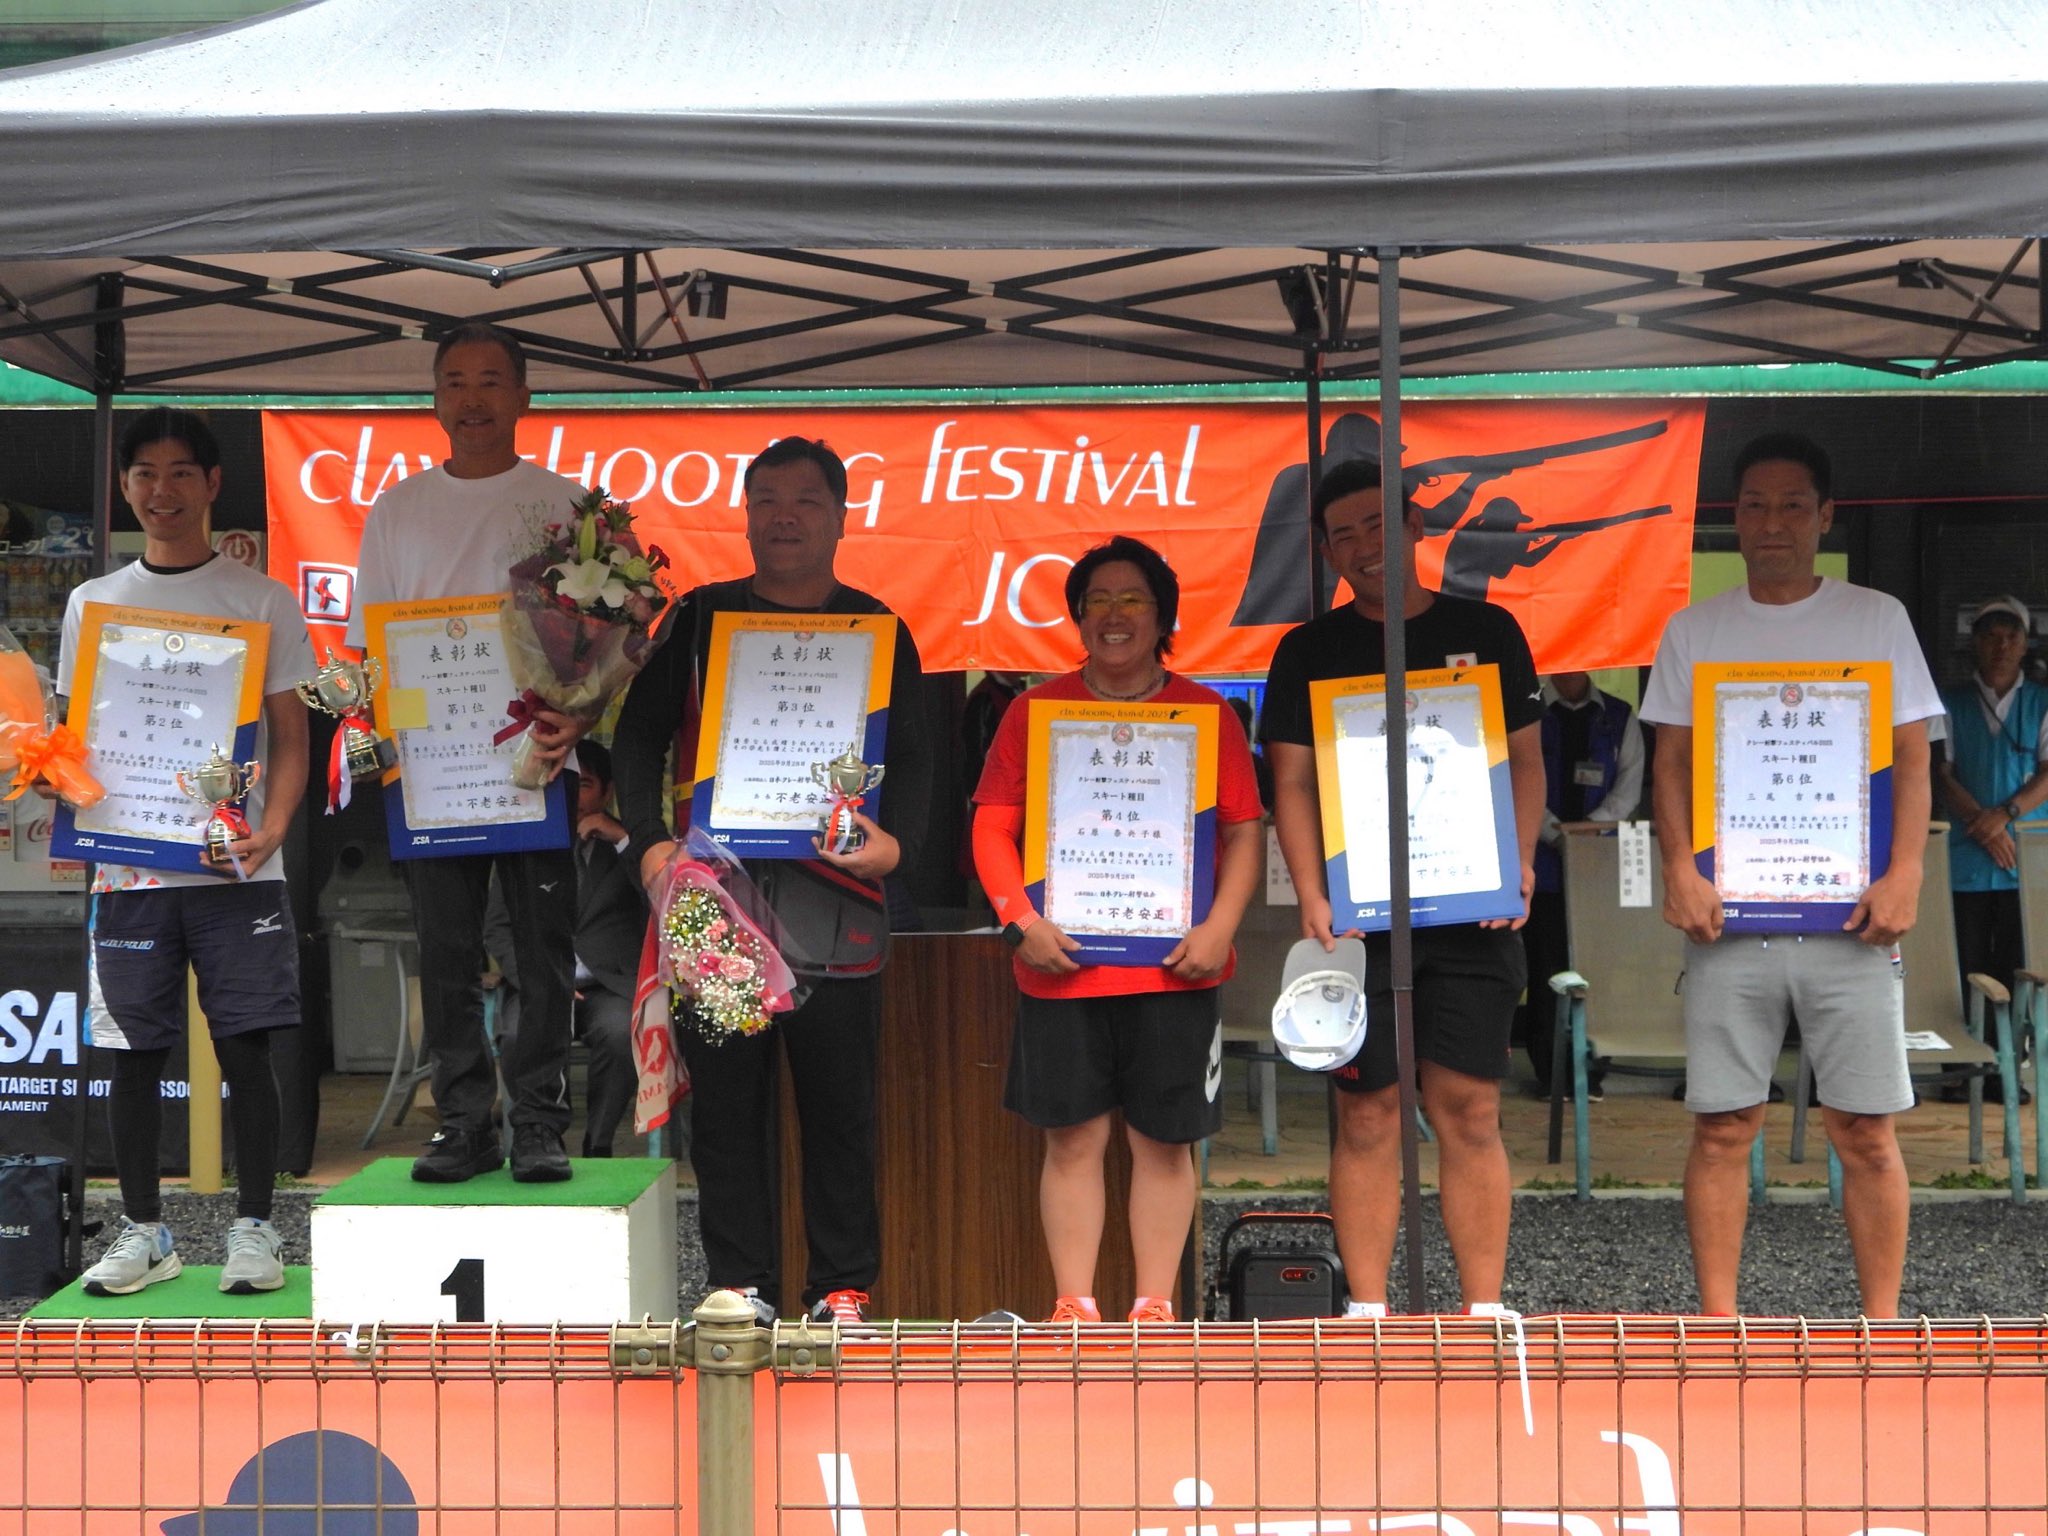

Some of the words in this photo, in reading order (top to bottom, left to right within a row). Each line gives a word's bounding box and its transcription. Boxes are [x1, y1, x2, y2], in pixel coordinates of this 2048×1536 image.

[429, 642, 491, 663] 表彰状
[771, 645, 834, 662] 表彰状
[139, 654, 203, 677] 表彰状
[437, 684, 487, 696] スキート種目
[770, 684, 821, 694] スキート種目
[137, 696, 191, 711] スキート種目
[448, 702, 485, 716] 第1位
[777, 701, 815, 713] 第3位
[144, 714, 183, 729] 第2位
[1758, 710, 1826, 729] 表彰状
[1090, 748, 1155, 767] 表彰状
[1762, 755, 1817, 764] スキート種目
[1772, 773, 1813, 785] 第6位
[1092, 791, 1145, 801] スキート種目
[142, 811, 198, 828] 不老安正
[1101, 809, 1140, 822] 第4位
[75, 838, 95, 848] JCSA
[412, 836, 430, 845] JCSA
[1782, 873, 1841, 886] 不老安正
[1108, 906, 1165, 920] 不老安正
[1356, 907, 1376, 918] JCSA
[1722, 908, 1739, 918] CSA
[0, 1077, 58, 1095] TARGET
[0, 1101, 49, 1112] AMENT
[441, 1259, 485, 1322] 1
